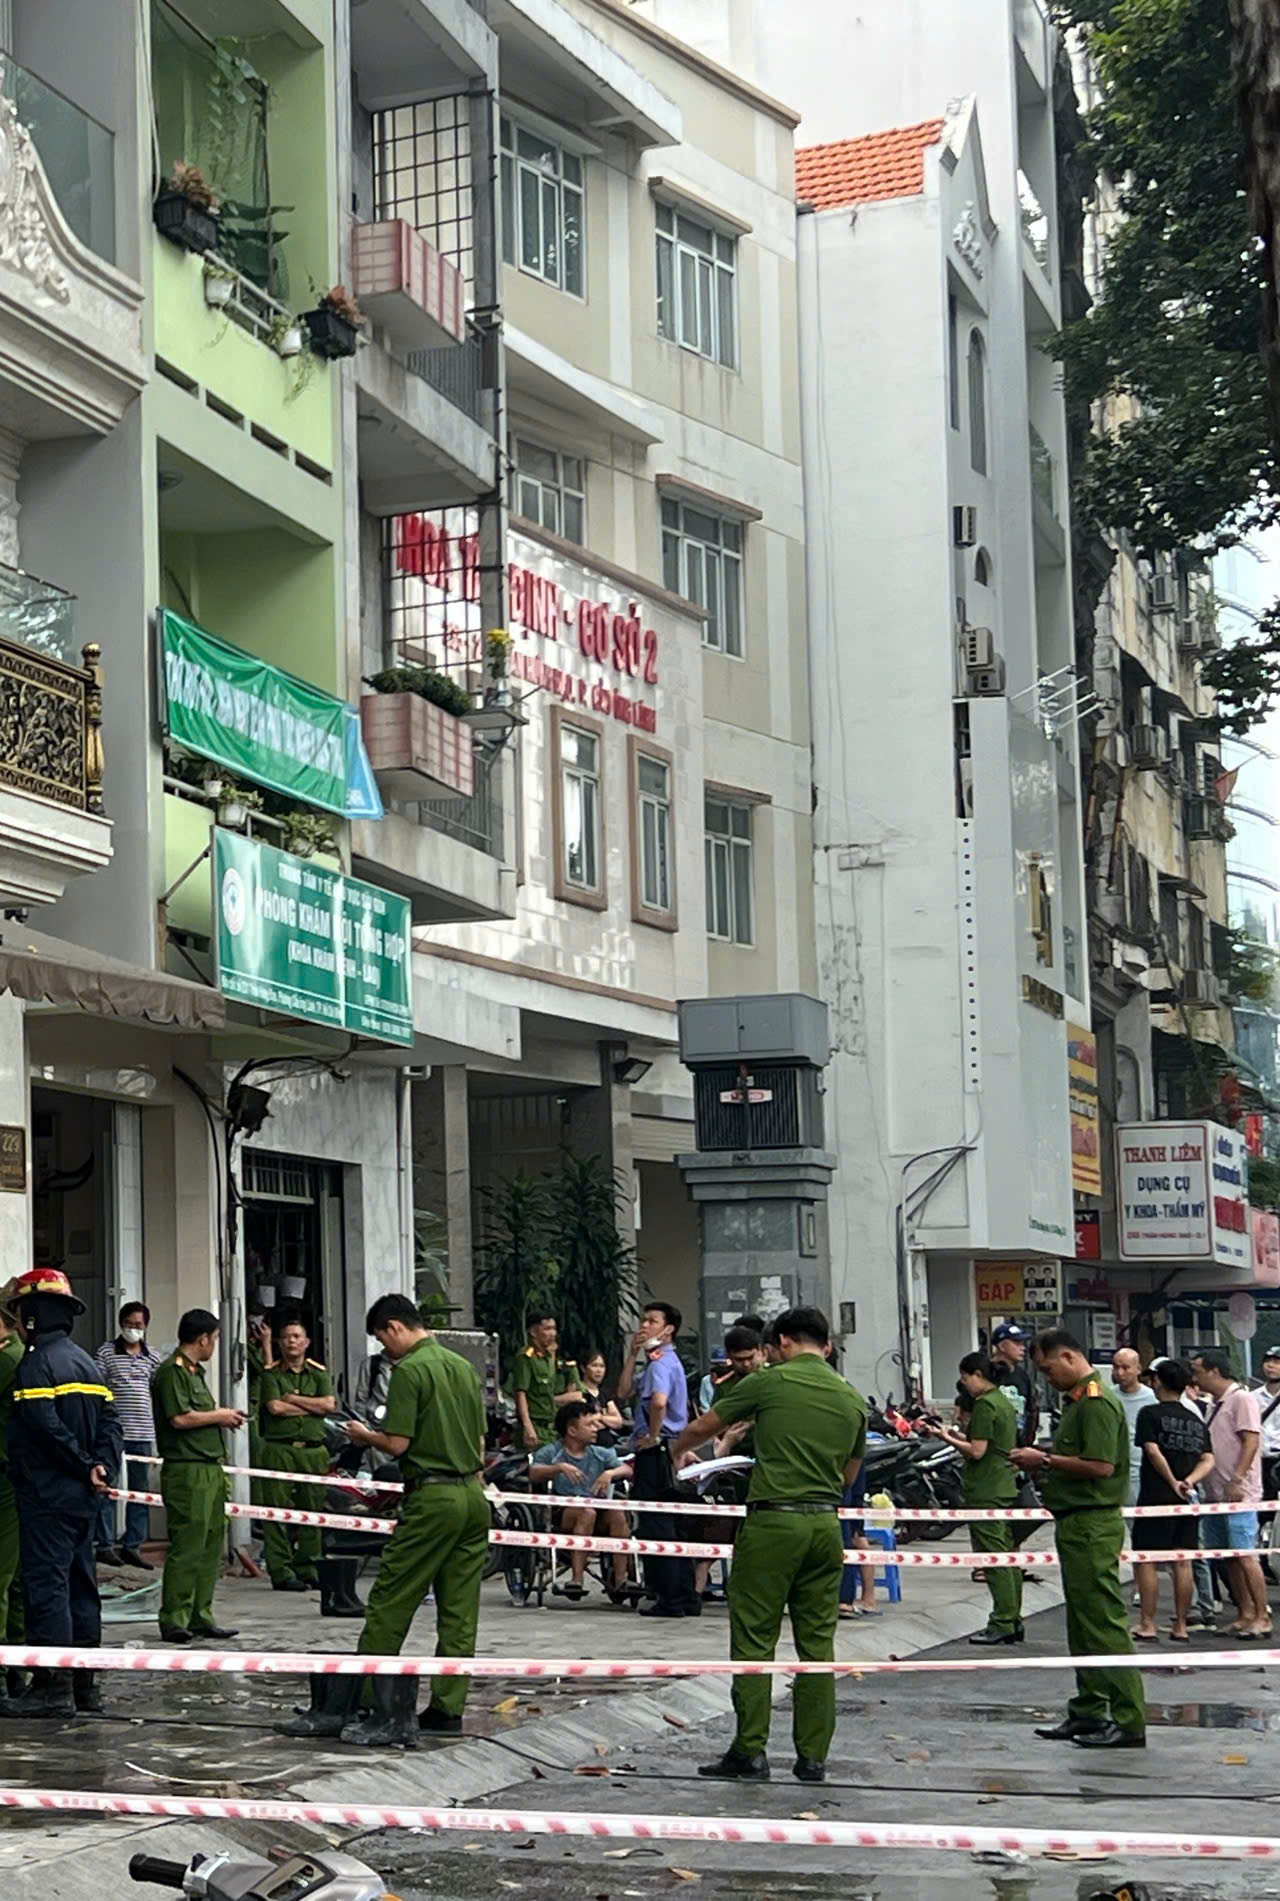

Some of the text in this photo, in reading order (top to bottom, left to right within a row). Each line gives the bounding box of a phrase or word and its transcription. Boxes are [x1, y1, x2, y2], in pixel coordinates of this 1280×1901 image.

[644, 630, 659, 685] 2
[1123, 1142, 1203, 1163] THANH LIÊM
[1137, 1175, 1191, 1194] DỤNG CỤ
